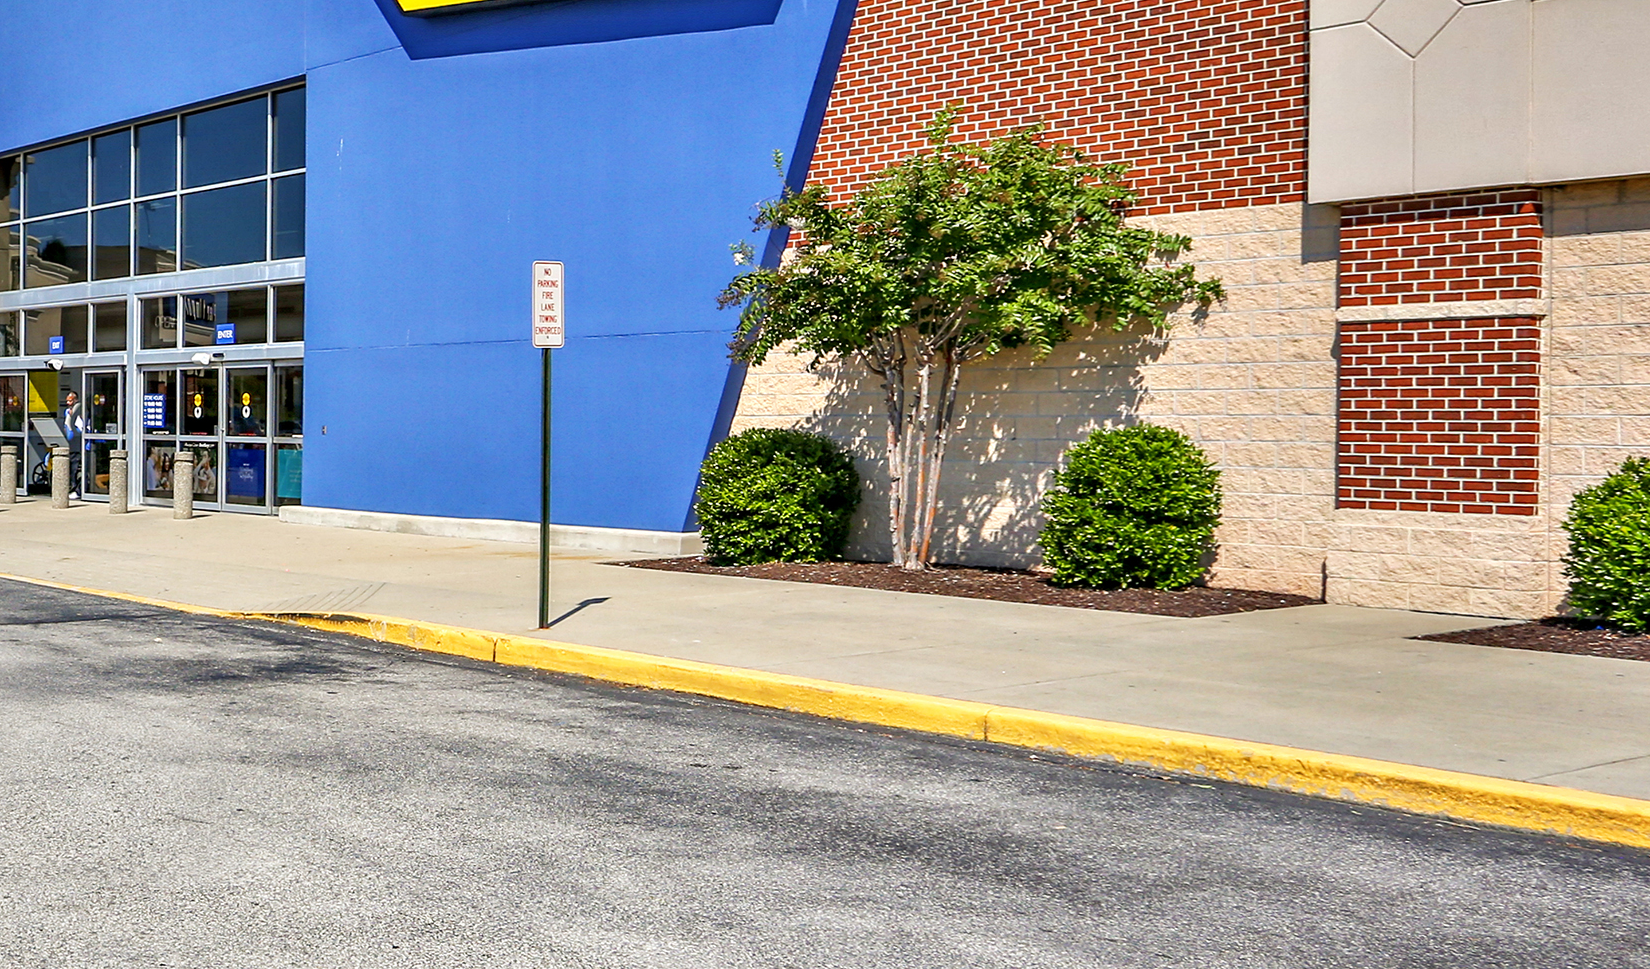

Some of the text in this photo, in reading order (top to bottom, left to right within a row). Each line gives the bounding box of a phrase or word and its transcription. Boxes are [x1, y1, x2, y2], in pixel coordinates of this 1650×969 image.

[543, 268, 552, 276] NO
[537, 279, 559, 288] PARKING
[542, 291, 554, 300] FIRE
[540, 303, 555, 312] LANE
[539, 315, 558, 323] TOWING
[217, 329, 233, 339] ENTER
[535, 326, 561, 335] ENFORCED
[52, 341, 61, 350] EXIT
